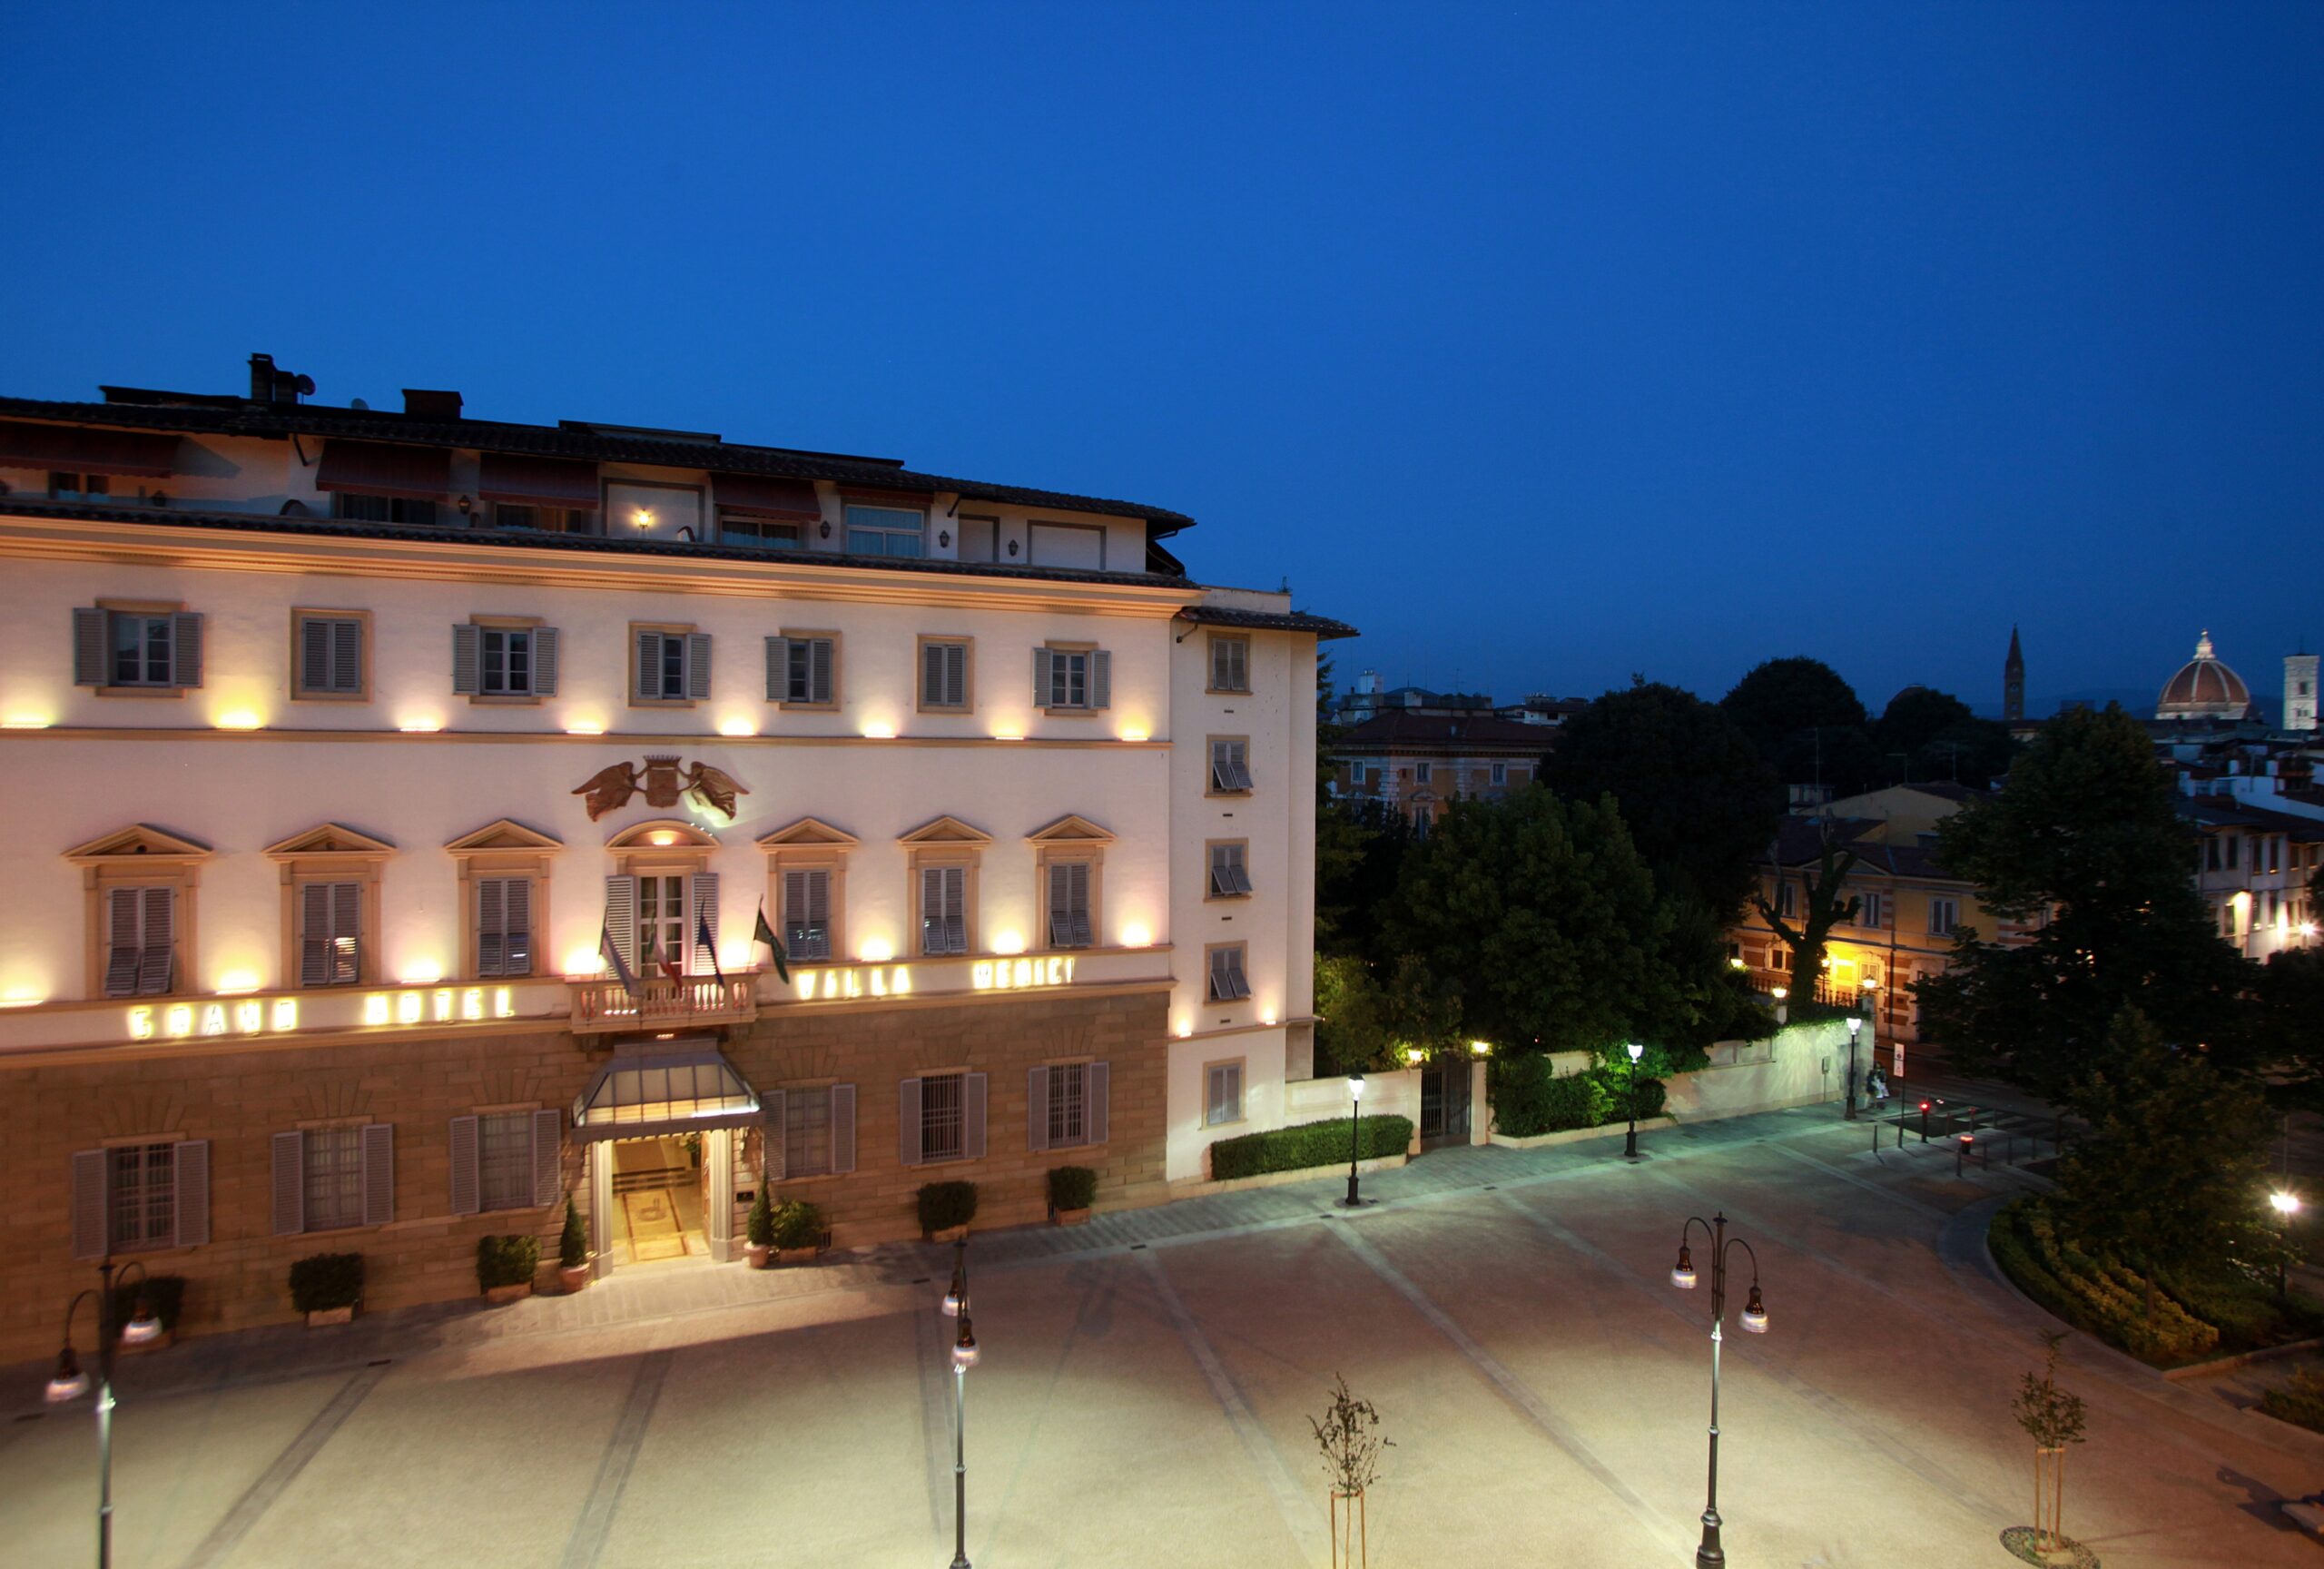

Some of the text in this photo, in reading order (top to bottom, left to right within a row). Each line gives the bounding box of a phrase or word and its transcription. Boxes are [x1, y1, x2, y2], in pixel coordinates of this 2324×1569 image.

[797, 958, 1075, 998] VILLA MEDICI
[129, 988, 515, 1038] GRAND HOTEL
